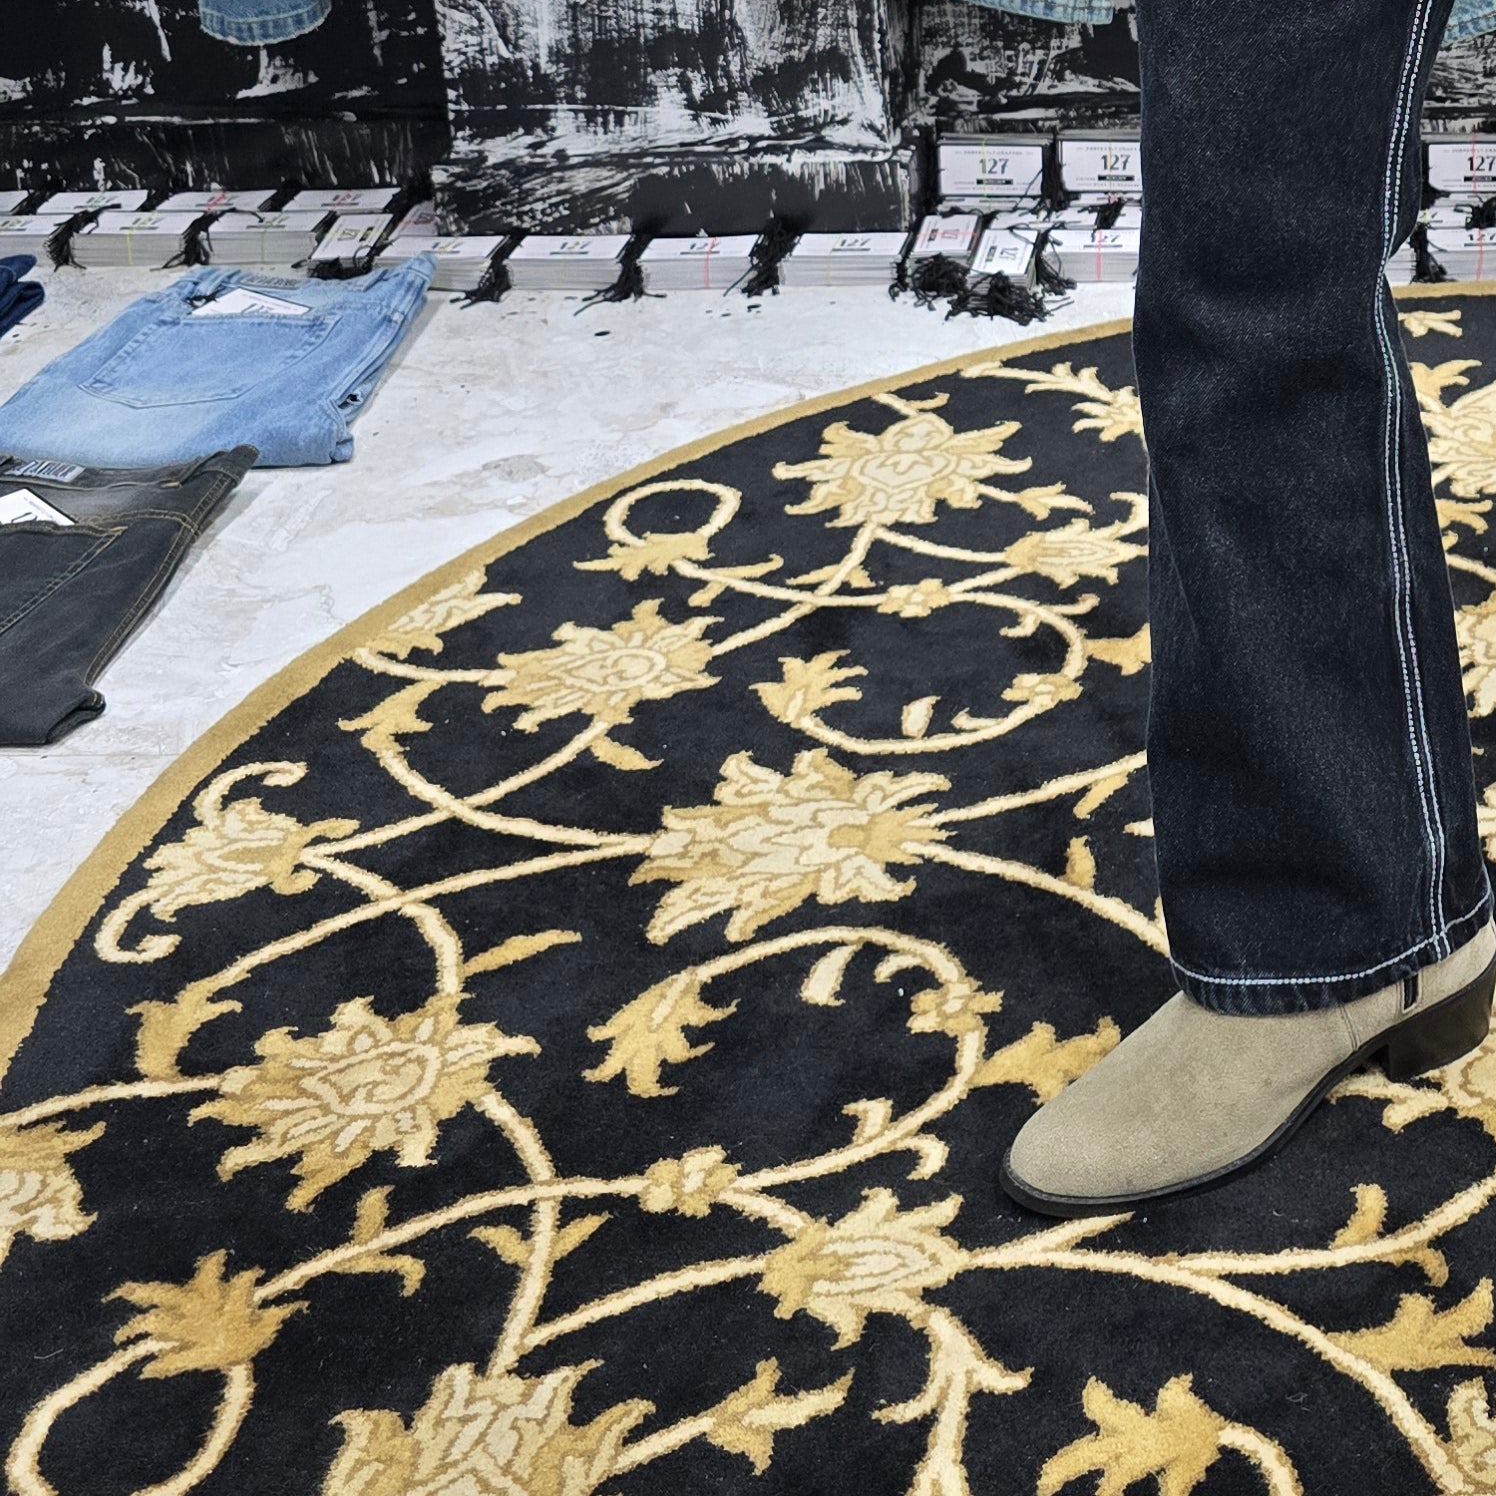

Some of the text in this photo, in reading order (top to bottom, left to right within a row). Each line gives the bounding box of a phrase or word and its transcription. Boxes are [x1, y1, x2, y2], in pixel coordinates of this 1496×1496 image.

[979, 158, 1009, 175] 127
[1101, 154, 1131, 171] 127
[1467, 155, 1496, 171] 127
[840, 238, 871, 247] 127
